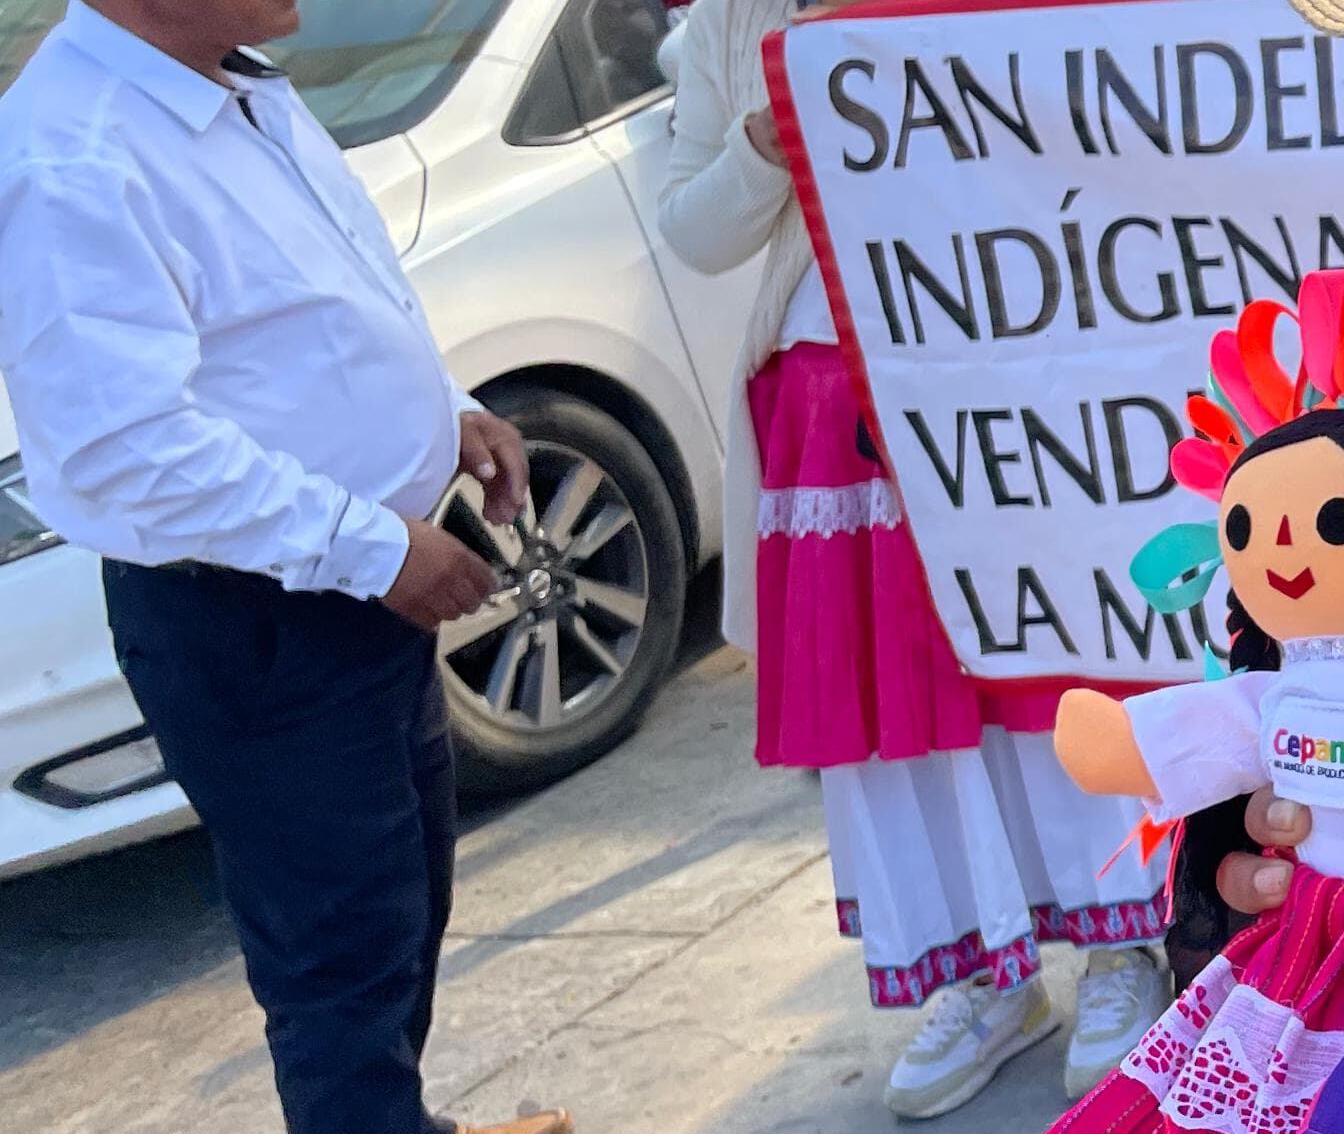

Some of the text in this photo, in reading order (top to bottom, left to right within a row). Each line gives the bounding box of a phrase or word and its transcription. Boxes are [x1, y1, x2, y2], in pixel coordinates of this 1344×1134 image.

[827, 50, 1045, 173] SAN
[902, 390, 1207, 510] VEND
[954, 564, 1080, 656] LA
